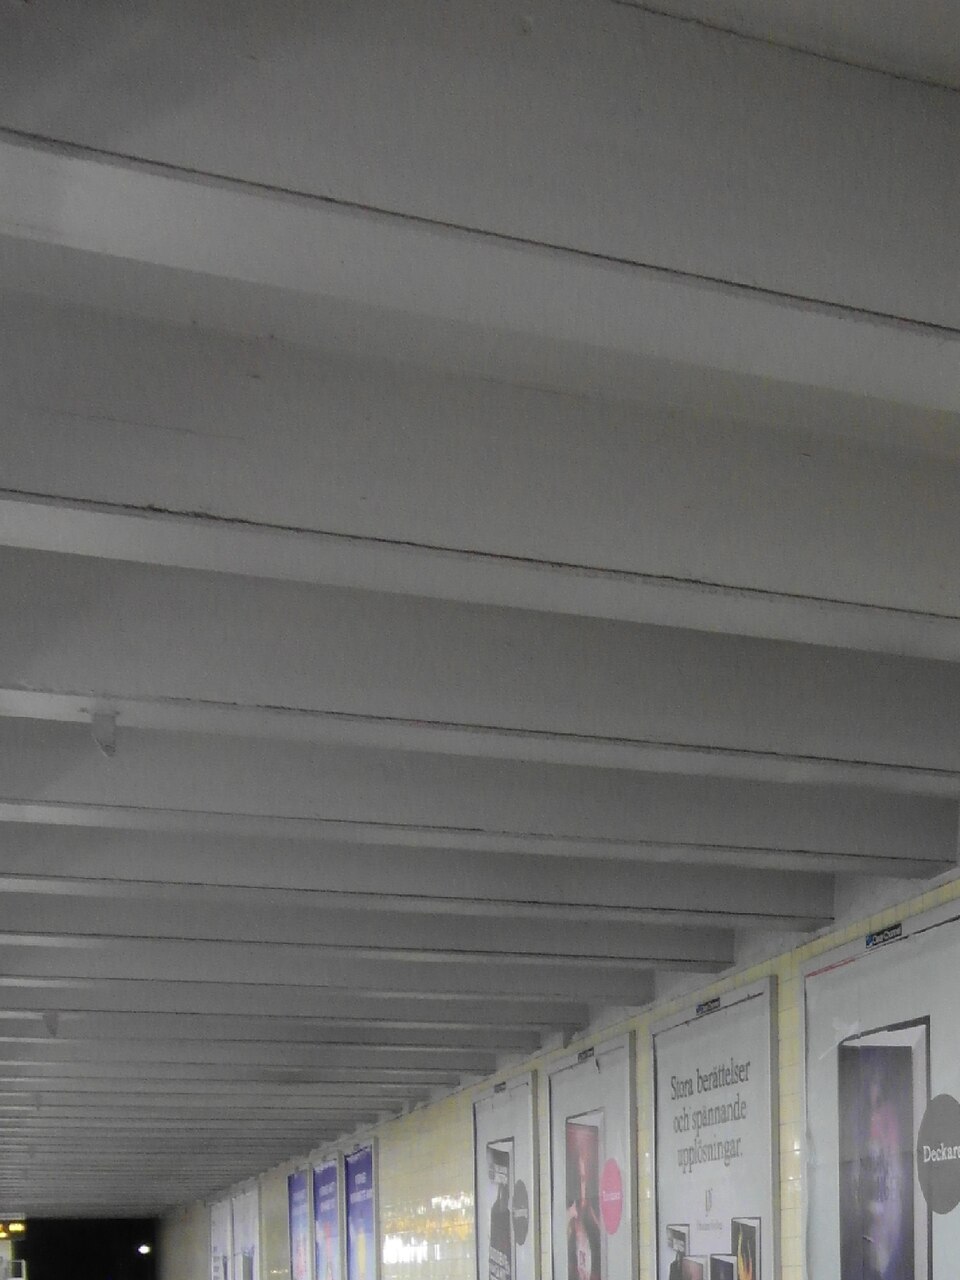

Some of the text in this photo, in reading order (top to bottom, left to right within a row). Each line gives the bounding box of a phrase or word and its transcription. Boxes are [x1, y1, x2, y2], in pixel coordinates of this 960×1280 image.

[671, 1057, 751, 1100] Stora berättelser
[673, 1092, 747, 1138] och spännande
[677, 1137, 743, 1174] upplösningar.
